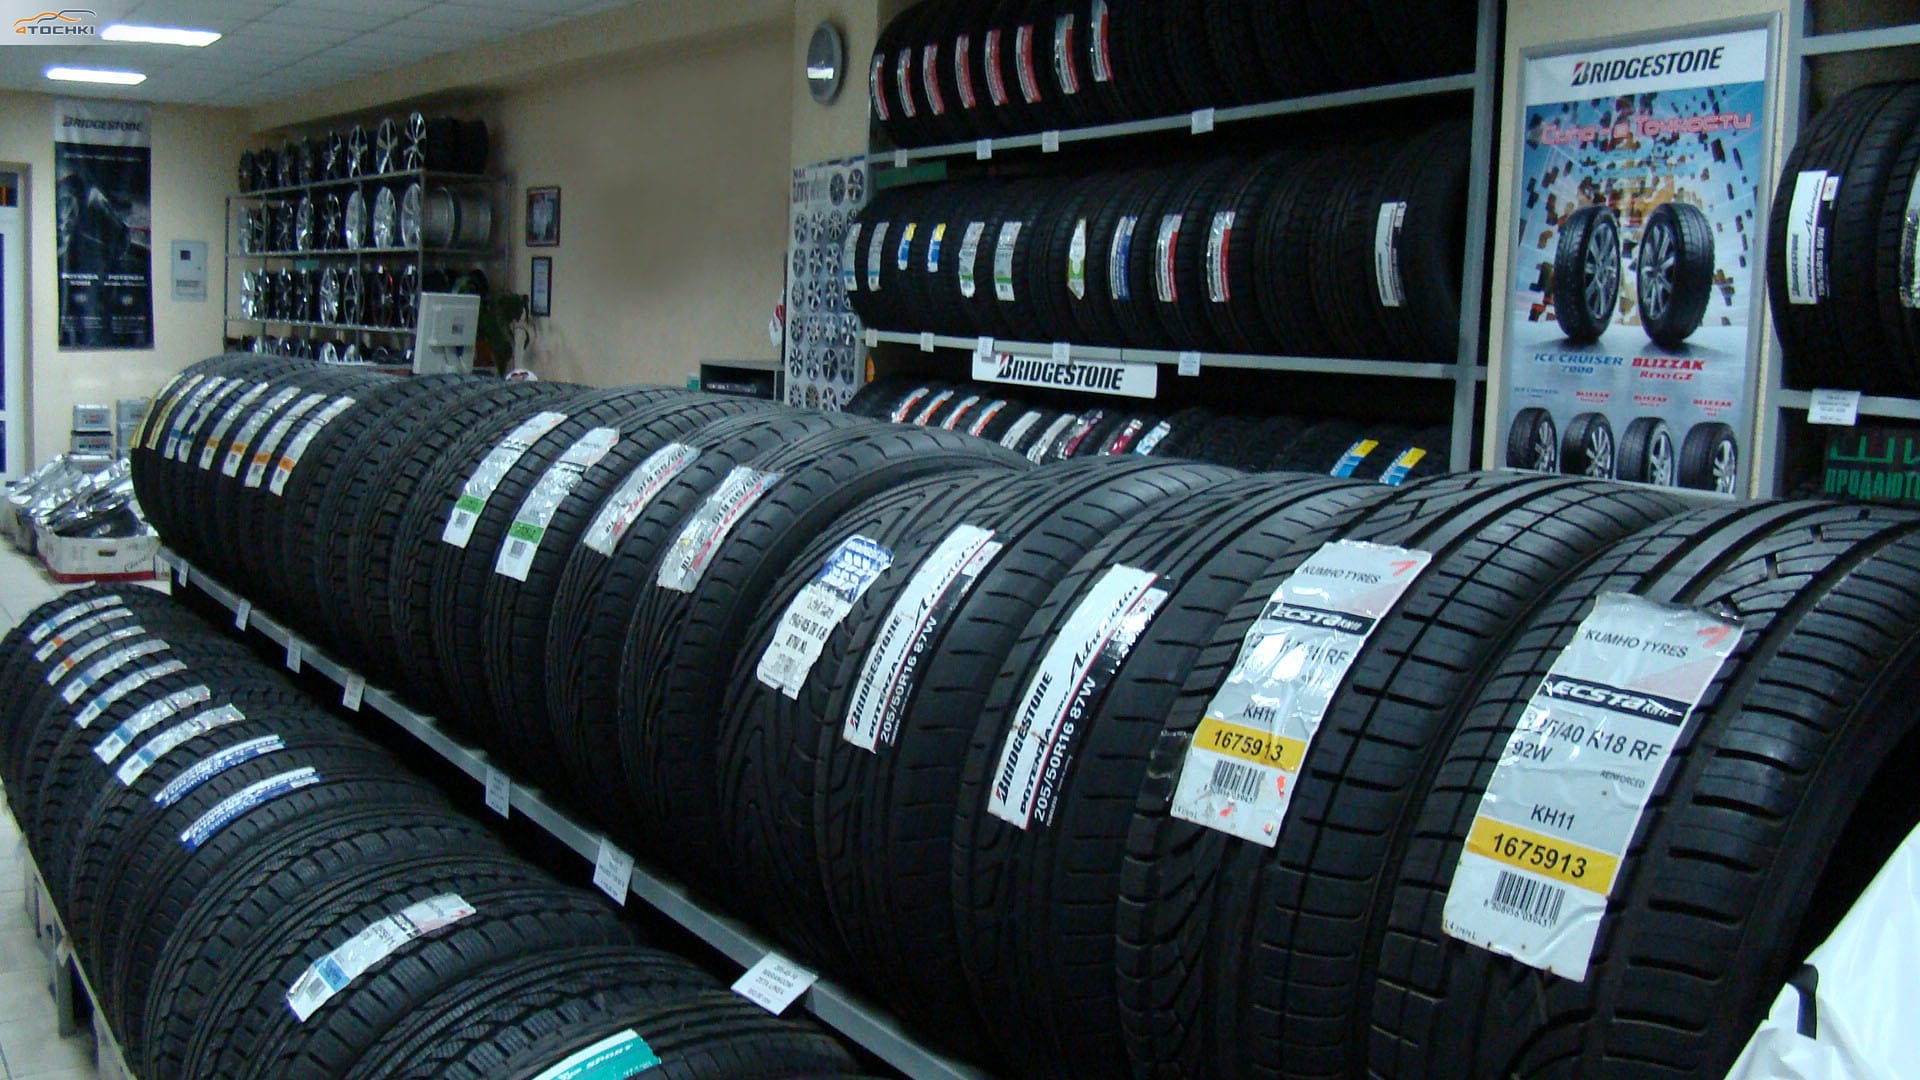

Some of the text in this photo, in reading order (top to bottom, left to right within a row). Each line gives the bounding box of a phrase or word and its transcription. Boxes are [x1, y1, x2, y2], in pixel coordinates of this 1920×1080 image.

[1571, 46, 1724, 86] BRIDGESTONE
[63, 115, 143, 132] BRIDGESTONE
[996, 352, 1124, 390] BRIDGESTONE
[1534, 352, 1624, 366] ICE CRUISER
[1632, 357, 1705, 371] BLIZZAK
[1302, 565, 1381, 584] KUMHO TYRES
[1585, 628, 1688, 658] KUMHO TYRES
[850, 615, 903, 730] BRIDGESTONE
[881, 615, 938, 743] 205/50R16 87W
[867, 661, 898, 738] POTENZA
[995, 672, 1054, 806] BRIDGESTONE
[1034, 675, 1097, 822] 205/50R16 87W
[1213, 729, 1284, 762] 1675913
[1512, 740, 1552, 762] 92W
[1629, 739, 1662, 762] RF
[1019, 728, 1053, 814] POTENZA
[1531, 804, 1575, 830] KH11
[1493, 833, 1587, 880] 1675913
